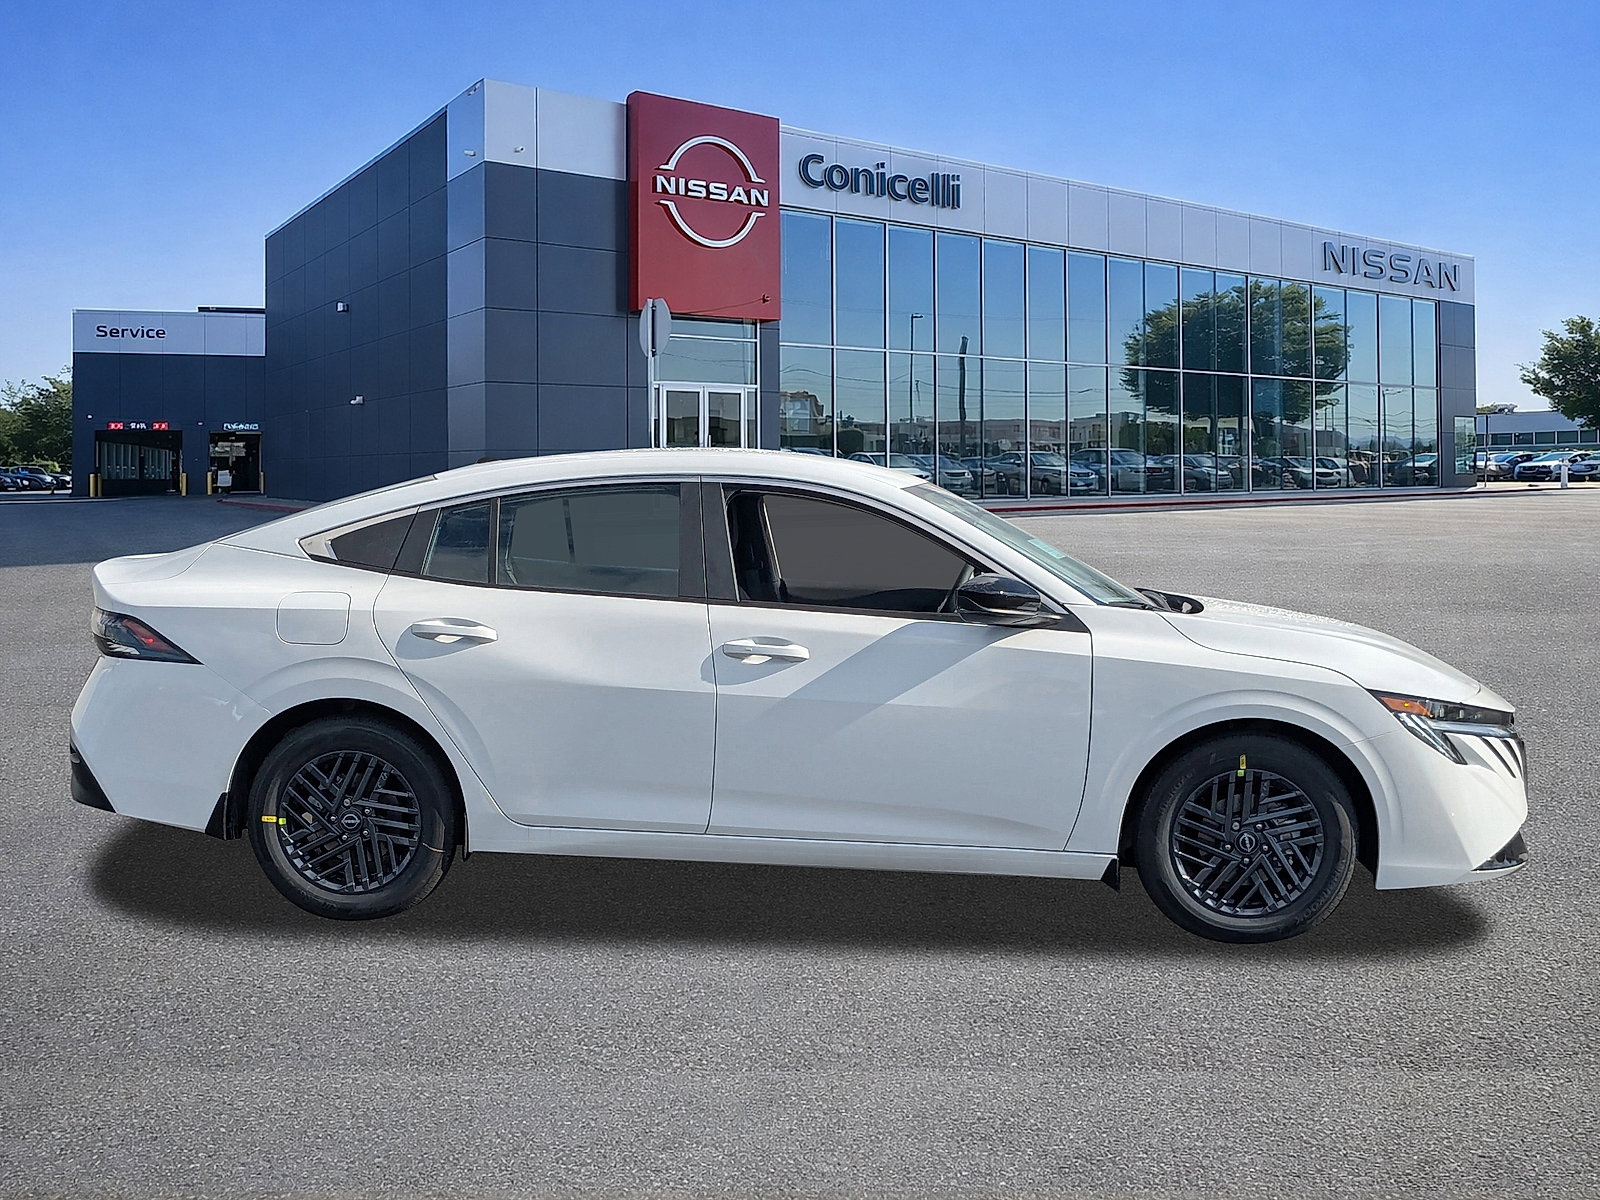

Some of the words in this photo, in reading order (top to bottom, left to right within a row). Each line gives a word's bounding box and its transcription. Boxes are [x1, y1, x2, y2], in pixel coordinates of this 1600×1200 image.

[654, 174, 769, 207] NISSAN
[799, 153, 962, 209] Conicelli
[1323, 241, 1461, 291] NISSAN
[95, 325, 167, 339] Service
